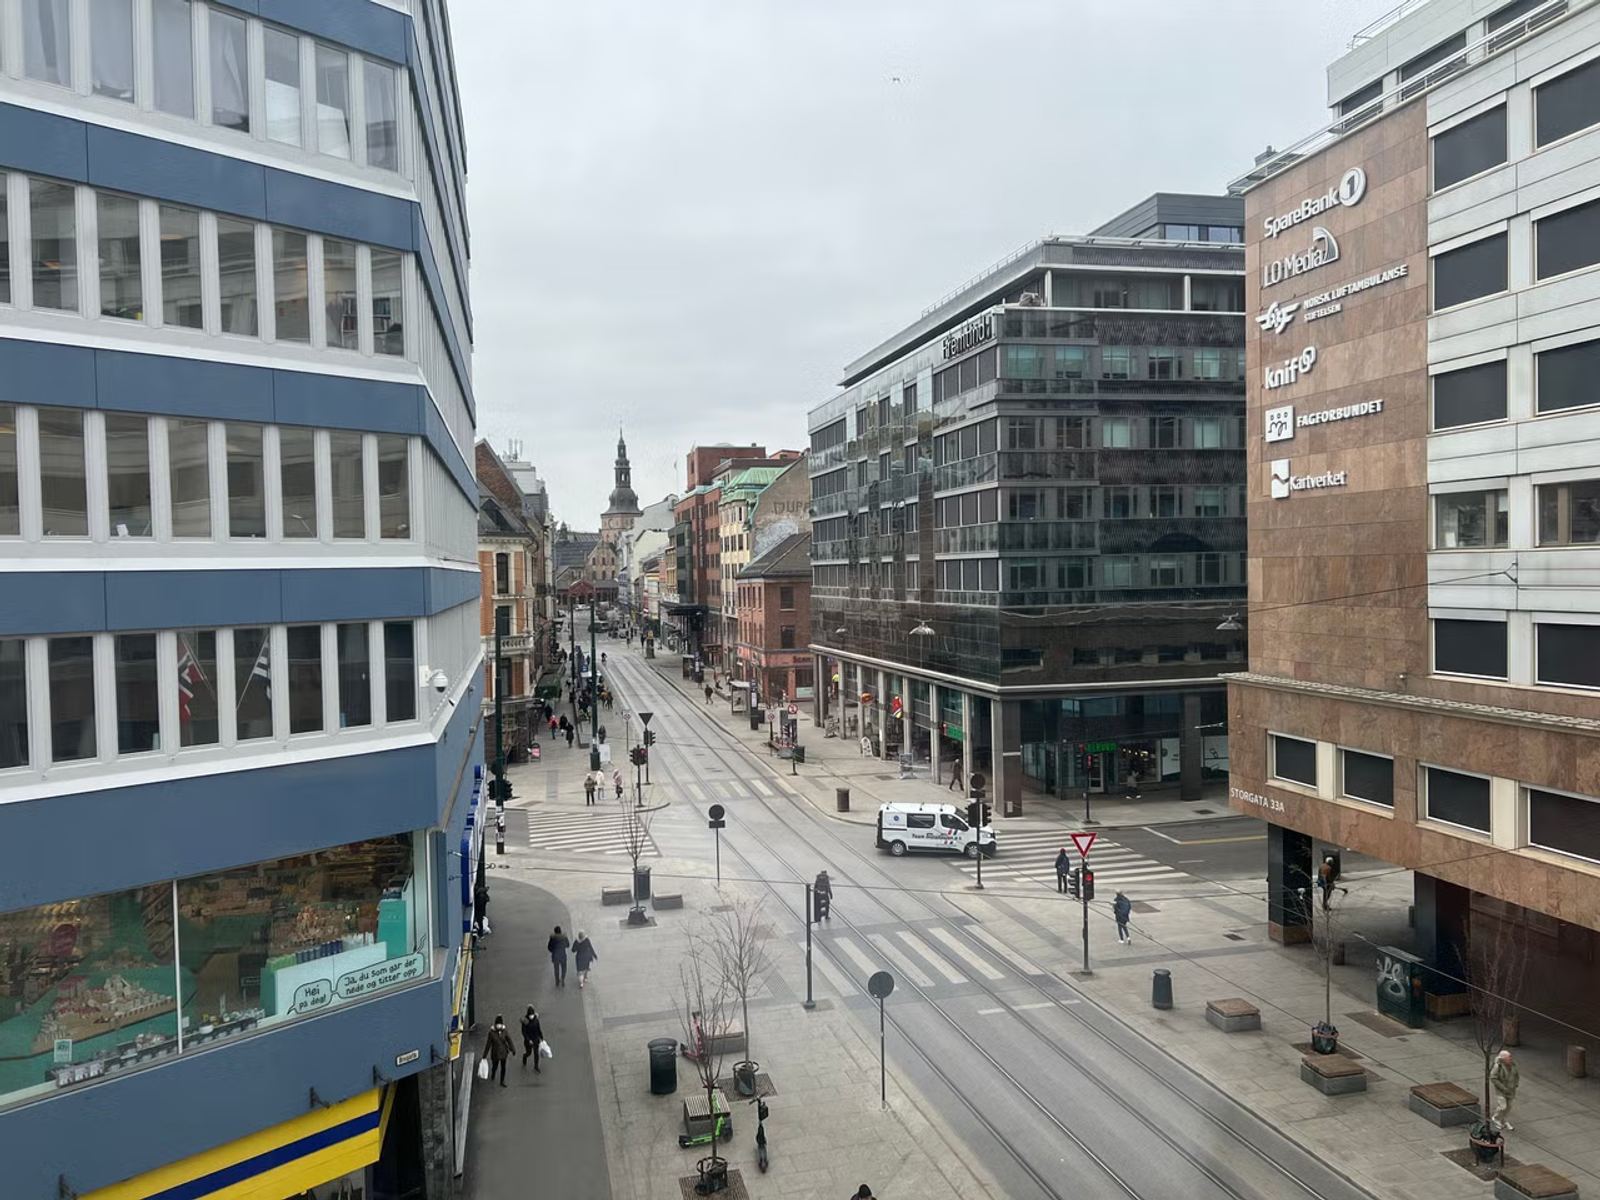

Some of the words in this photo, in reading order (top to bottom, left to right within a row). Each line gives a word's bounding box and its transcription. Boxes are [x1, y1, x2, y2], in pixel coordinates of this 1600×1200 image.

[1264, 187, 1341, 238] SpareBank
[1263, 260, 1282, 288] LO
[1284, 245, 1324, 279] Media
[1303, 292, 1331, 310] NORSK
[1331, 264, 1409, 300] LUFTAMBULANSE
[1265, 357, 1299, 389] knif
[1297, 399, 1384, 428] FAGFORBUNDET
[1290, 470, 1347, 491] Kartverket
[1230, 787, 1269, 808] STORGATA
[1270, 799, 1285, 813] 33A
[346, 984, 364, 995] nede
[366, 980, 377, 989] og
[378, 972, 401, 985] titter
[403, 967, 417, 978] opp
[359, 972, 369, 981] du
[404, 958, 417, 968] der
[304, 984, 320, 997] Hei
